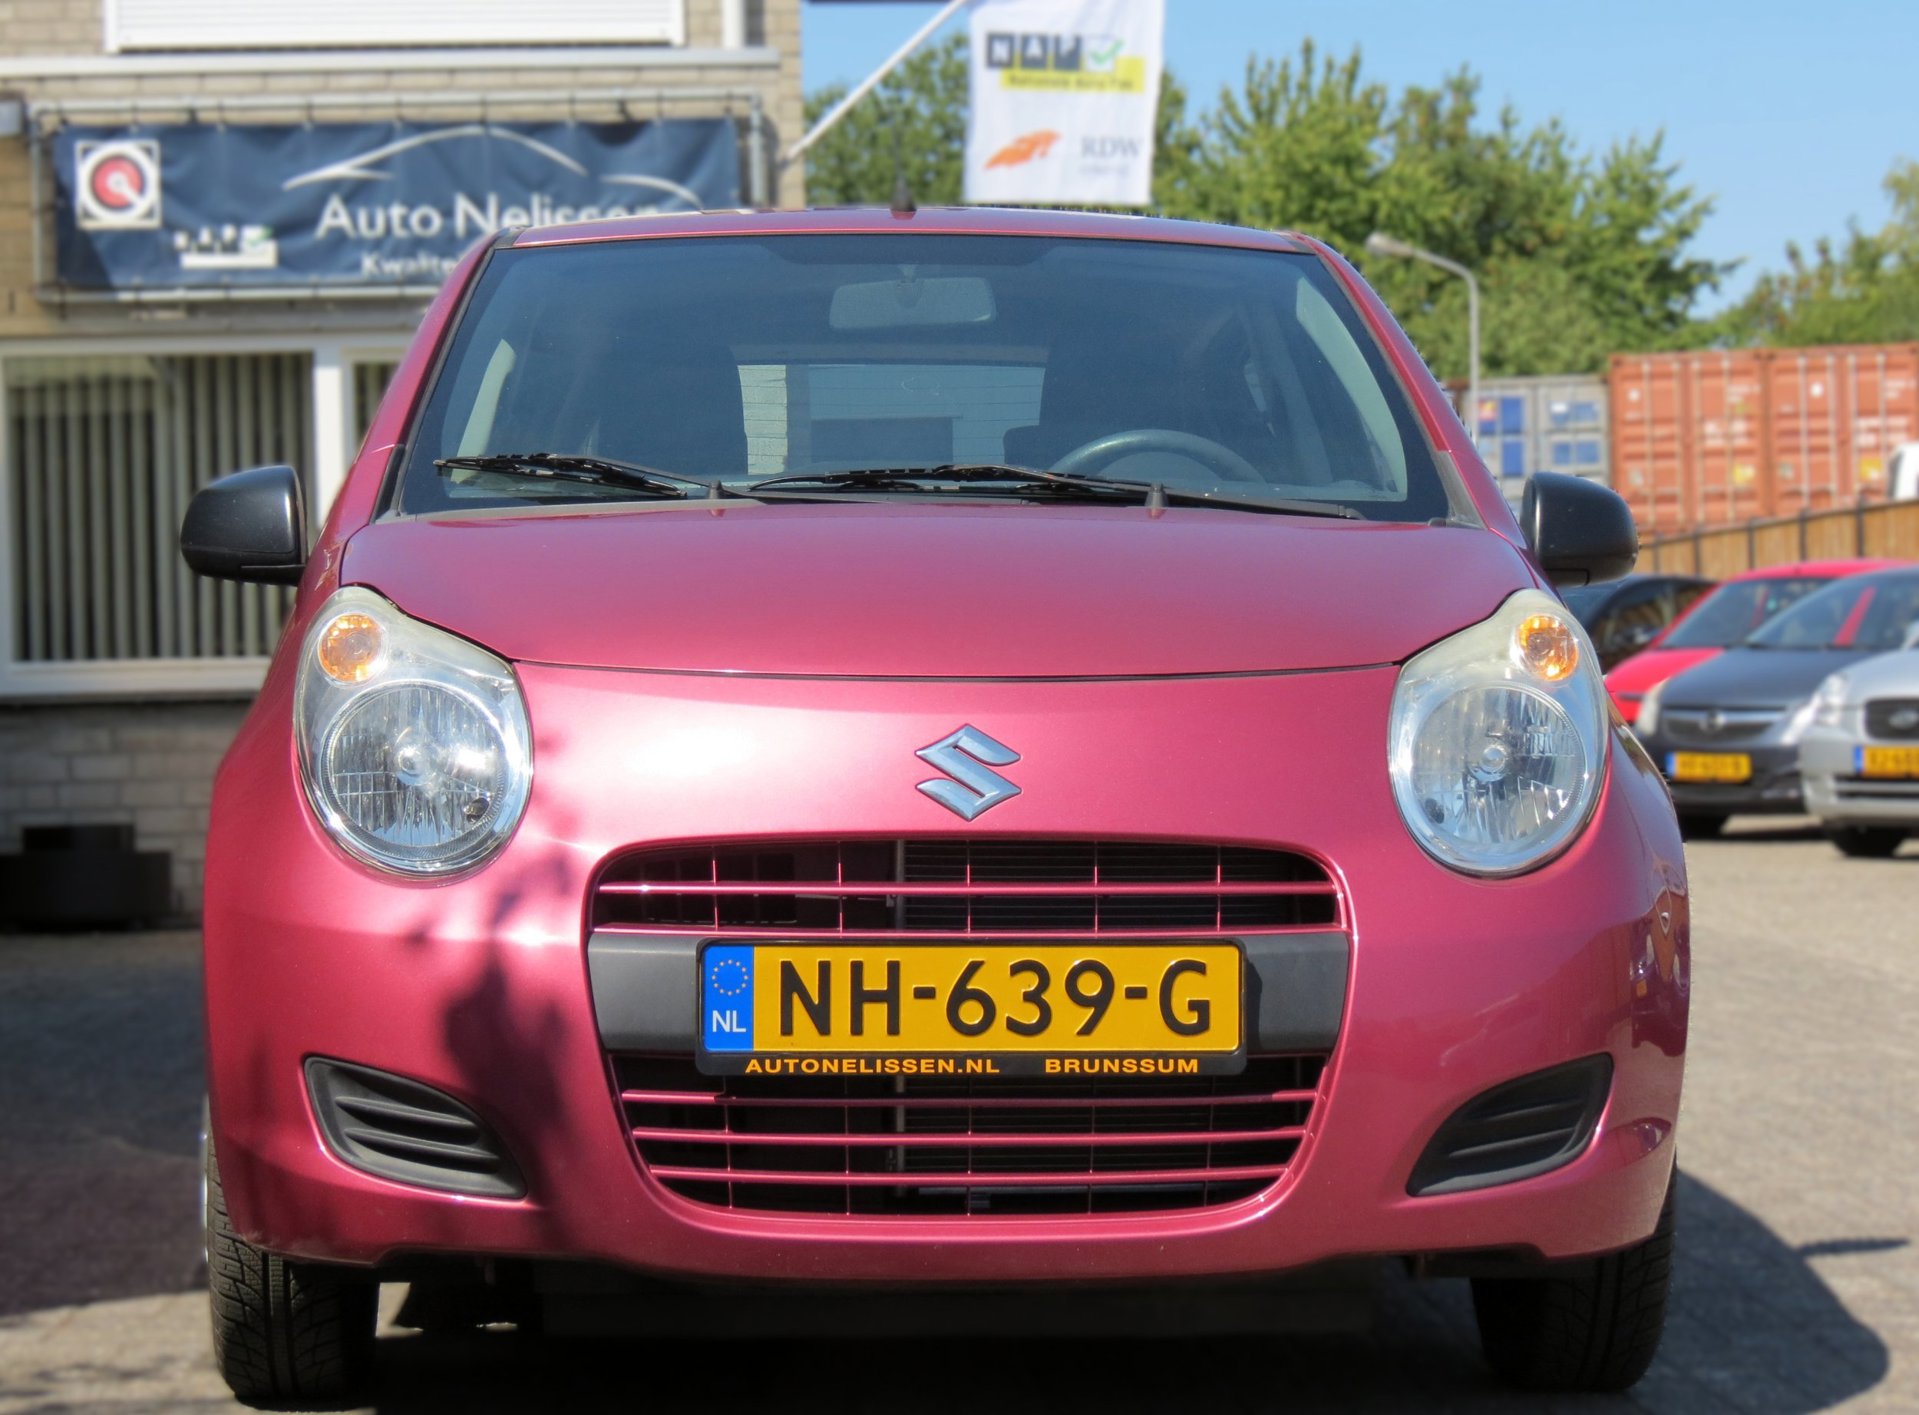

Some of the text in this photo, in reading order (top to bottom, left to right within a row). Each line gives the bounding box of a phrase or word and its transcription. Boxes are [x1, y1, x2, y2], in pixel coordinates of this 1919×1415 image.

[315, 194, 442, 239] Auto
[780, 959, 1211, 1037] NH-639-G
[712, 1010, 746, 1032] NL
[745, 1058, 1199, 1073] AUTONELISSEN.NL BRUNSSUM
